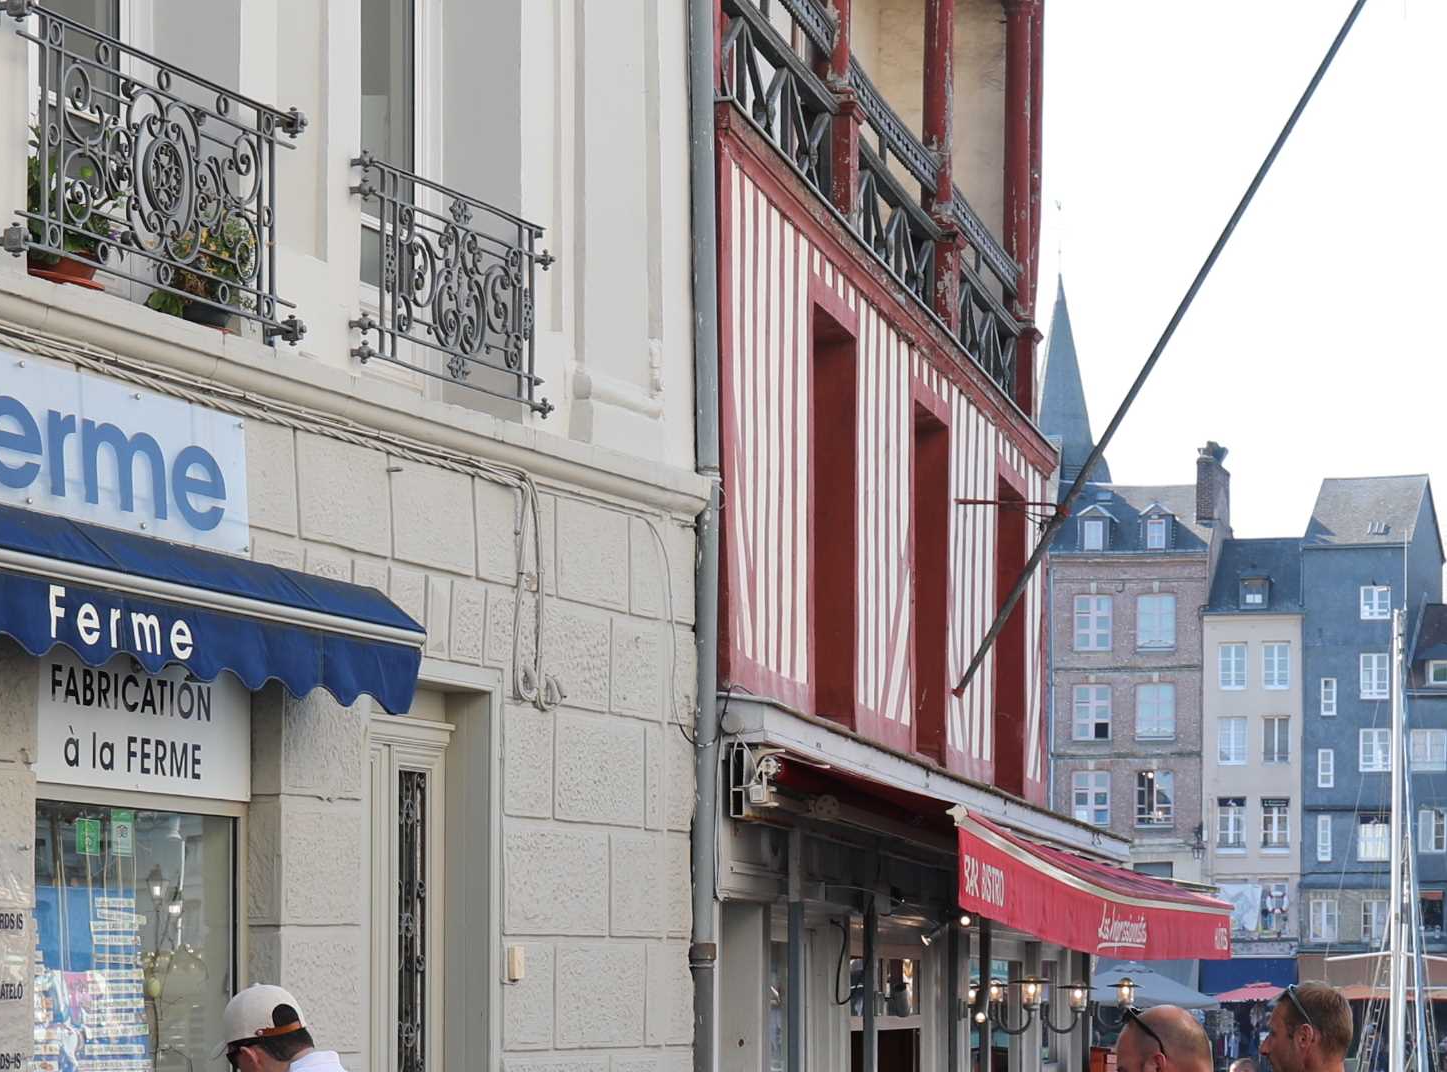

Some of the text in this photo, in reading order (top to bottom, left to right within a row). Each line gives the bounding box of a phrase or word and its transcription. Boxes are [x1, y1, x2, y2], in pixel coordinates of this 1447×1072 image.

[50, 585, 193, 660] Ferme
[51, 664, 212, 722] FABRICATION
[64, 725, 202, 780] à la FERME
